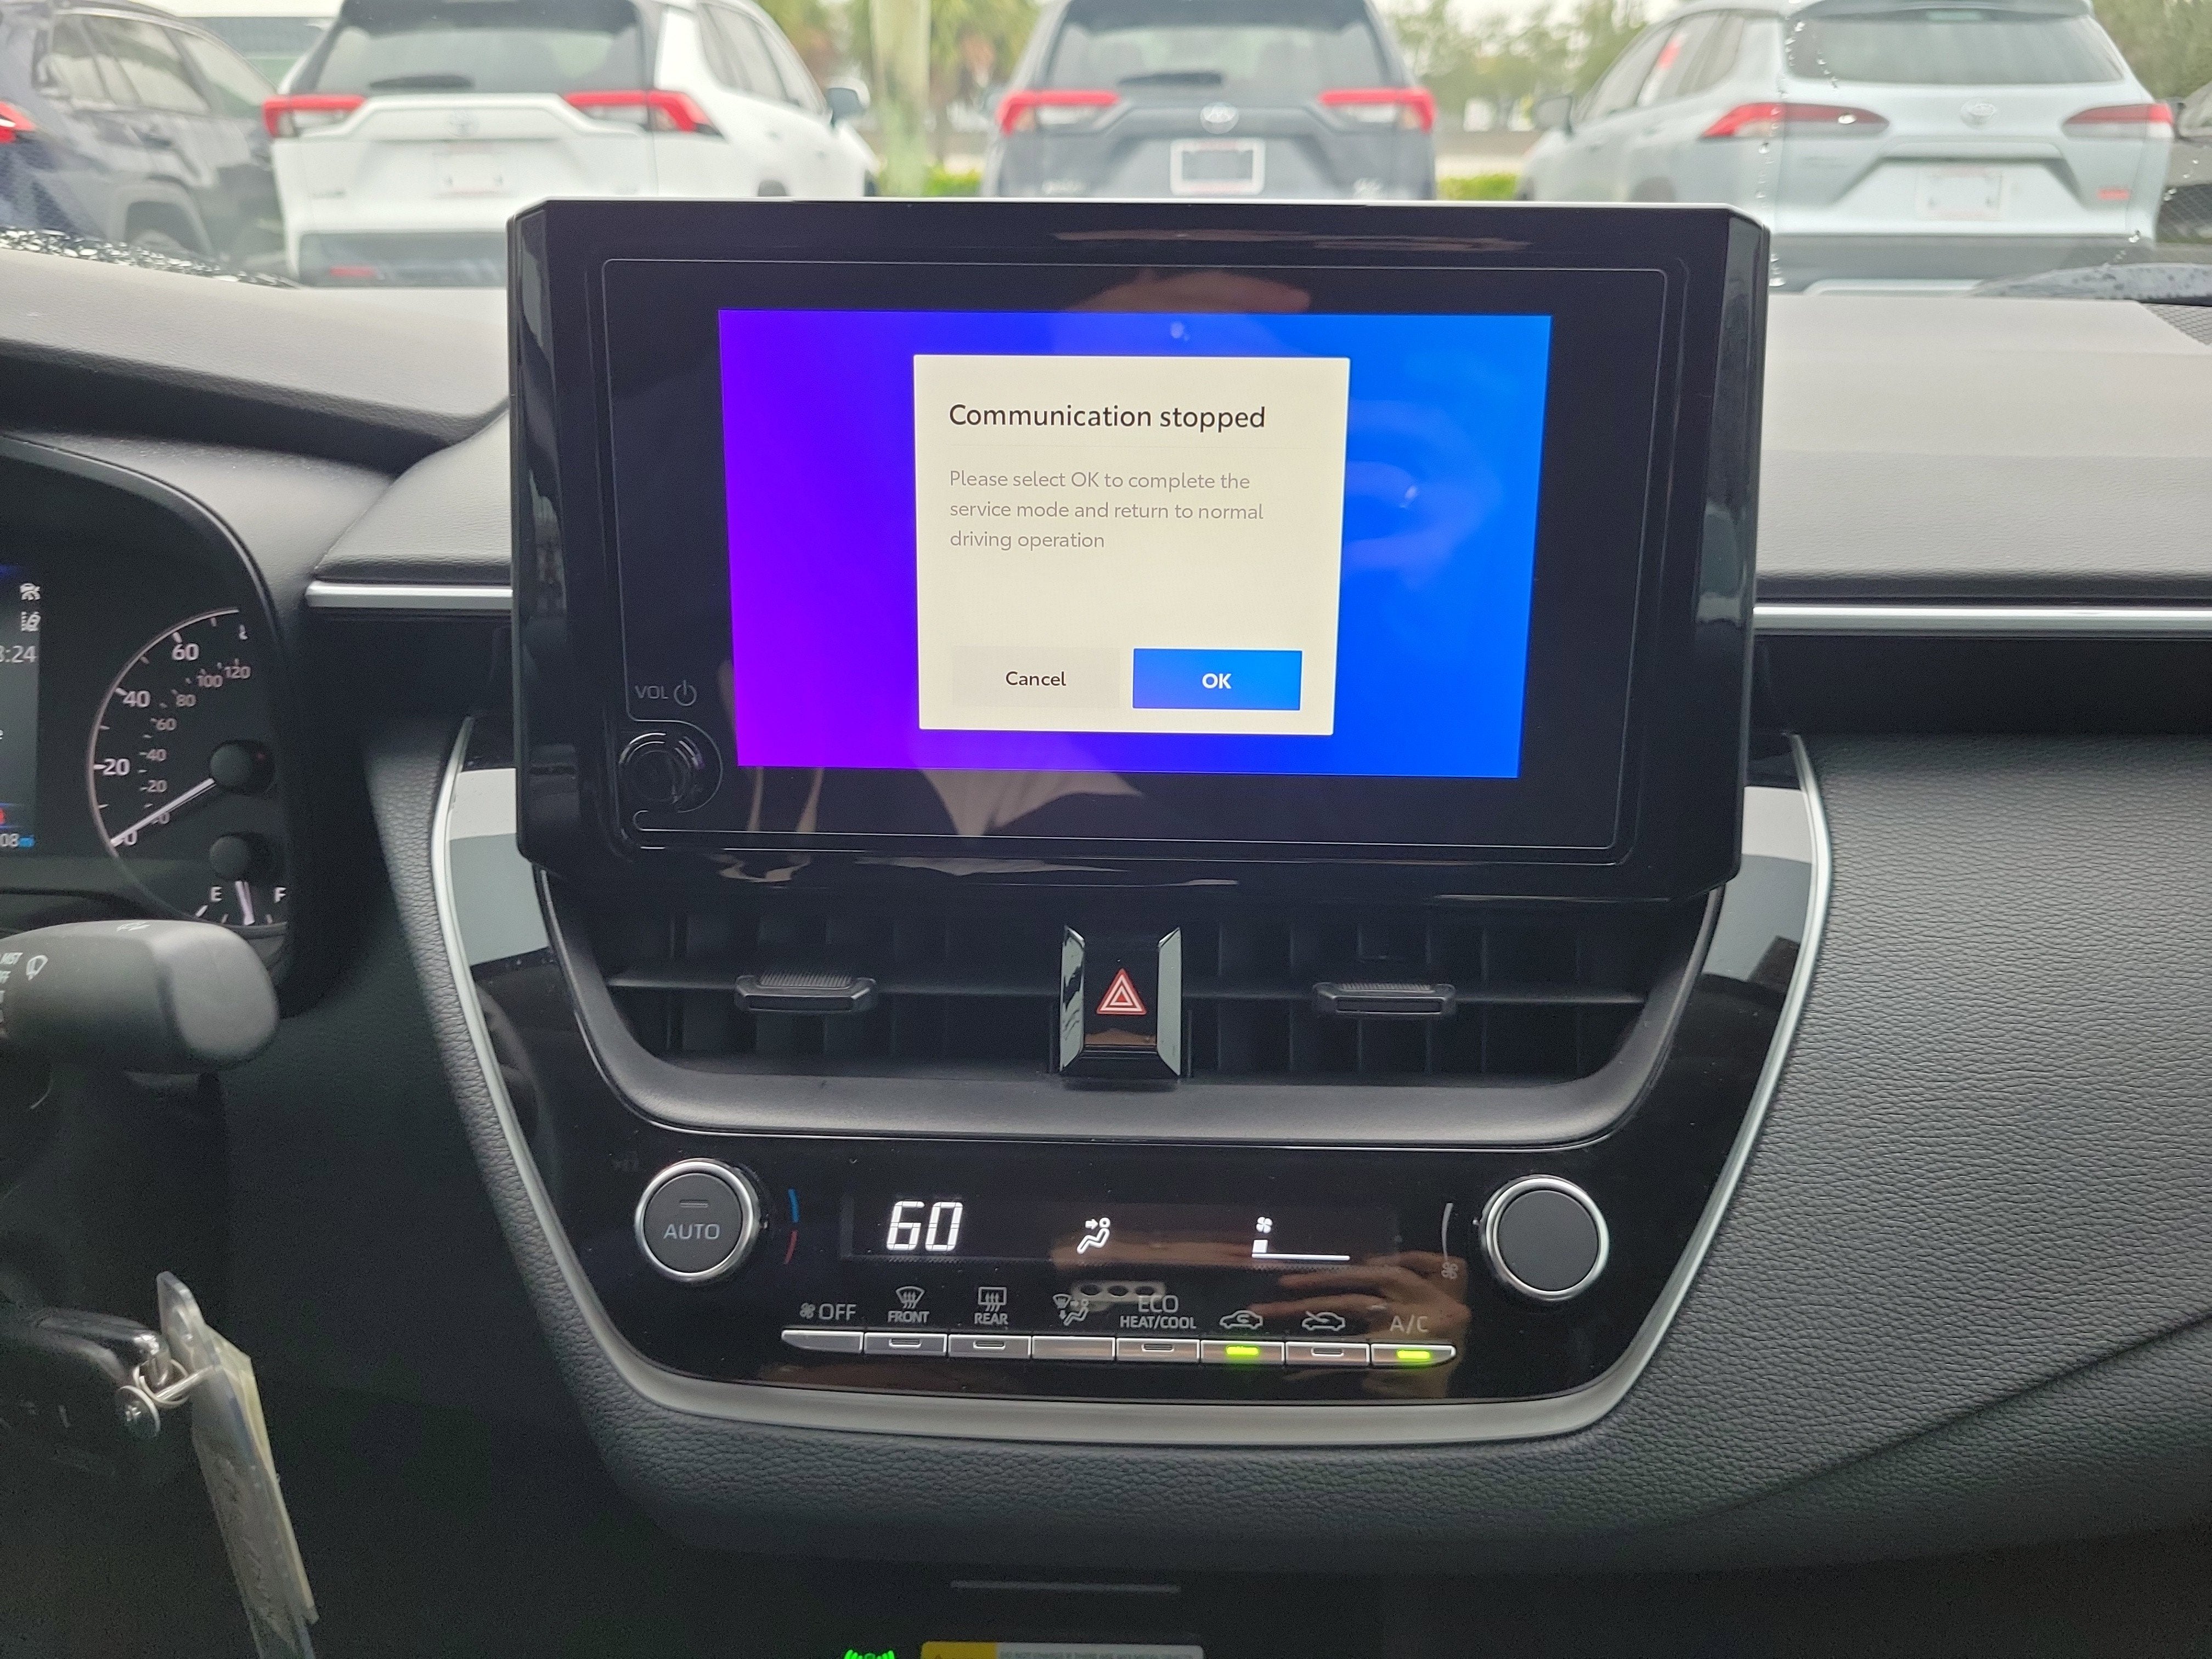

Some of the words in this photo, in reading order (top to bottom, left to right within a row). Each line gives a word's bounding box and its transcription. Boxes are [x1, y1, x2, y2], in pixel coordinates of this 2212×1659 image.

[949, 403, 1152, 427] Communication
[1159, 405, 1266, 433] stopped
[950, 470, 1008, 488] Please
[1013, 470, 1066, 488] select
[1071, 471, 1100, 488] OK
[1104, 473, 1124, 489] to
[1128, 471, 1216, 493] complete
[1220, 472, 1250, 490] the
[950, 501, 1012, 517] service
[1017, 501, 1070, 518] mode
[1074, 501, 1109, 518] and
[1114, 504, 1169, 519] return
[1175, 504, 1193, 519] to
[1198, 503, 1264, 520] normal
[950, 530, 1012, 551] driving
[1017, 531, 1105, 552] operation
[172, 643, 199, 661] 60
[197, 675, 223, 687] 100
[224, 666, 251, 679] 120
[1006, 670, 1067, 687] Cancel
[1201, 673, 1232, 690] OK
[122, 690, 151, 708] 40
[176, 693, 196, 707] 80
[635, 685, 669, 699] VOL
[155, 718, 177, 731] 60
[146, 748, 167, 761] 40
[103, 758, 130, 776] 20
[147, 780, 167, 793] 20
[125, 830, 137, 845] 0
[211, 886, 222, 902] E
[274, 887, 286, 902] F
[663, 1223, 720, 1240] AUTO
[886, 1200, 963, 1252] 60
[819, 1302, 856, 1321] OFF
[1138, 1295, 1179, 1313] ECO
[887, 1310, 930, 1323] FRONT
[974, 1312, 1009, 1325] REAR
[1119, 1314, 1197, 1330] HEAT/COOL
[1390, 1316, 1428, 1334] A/C
